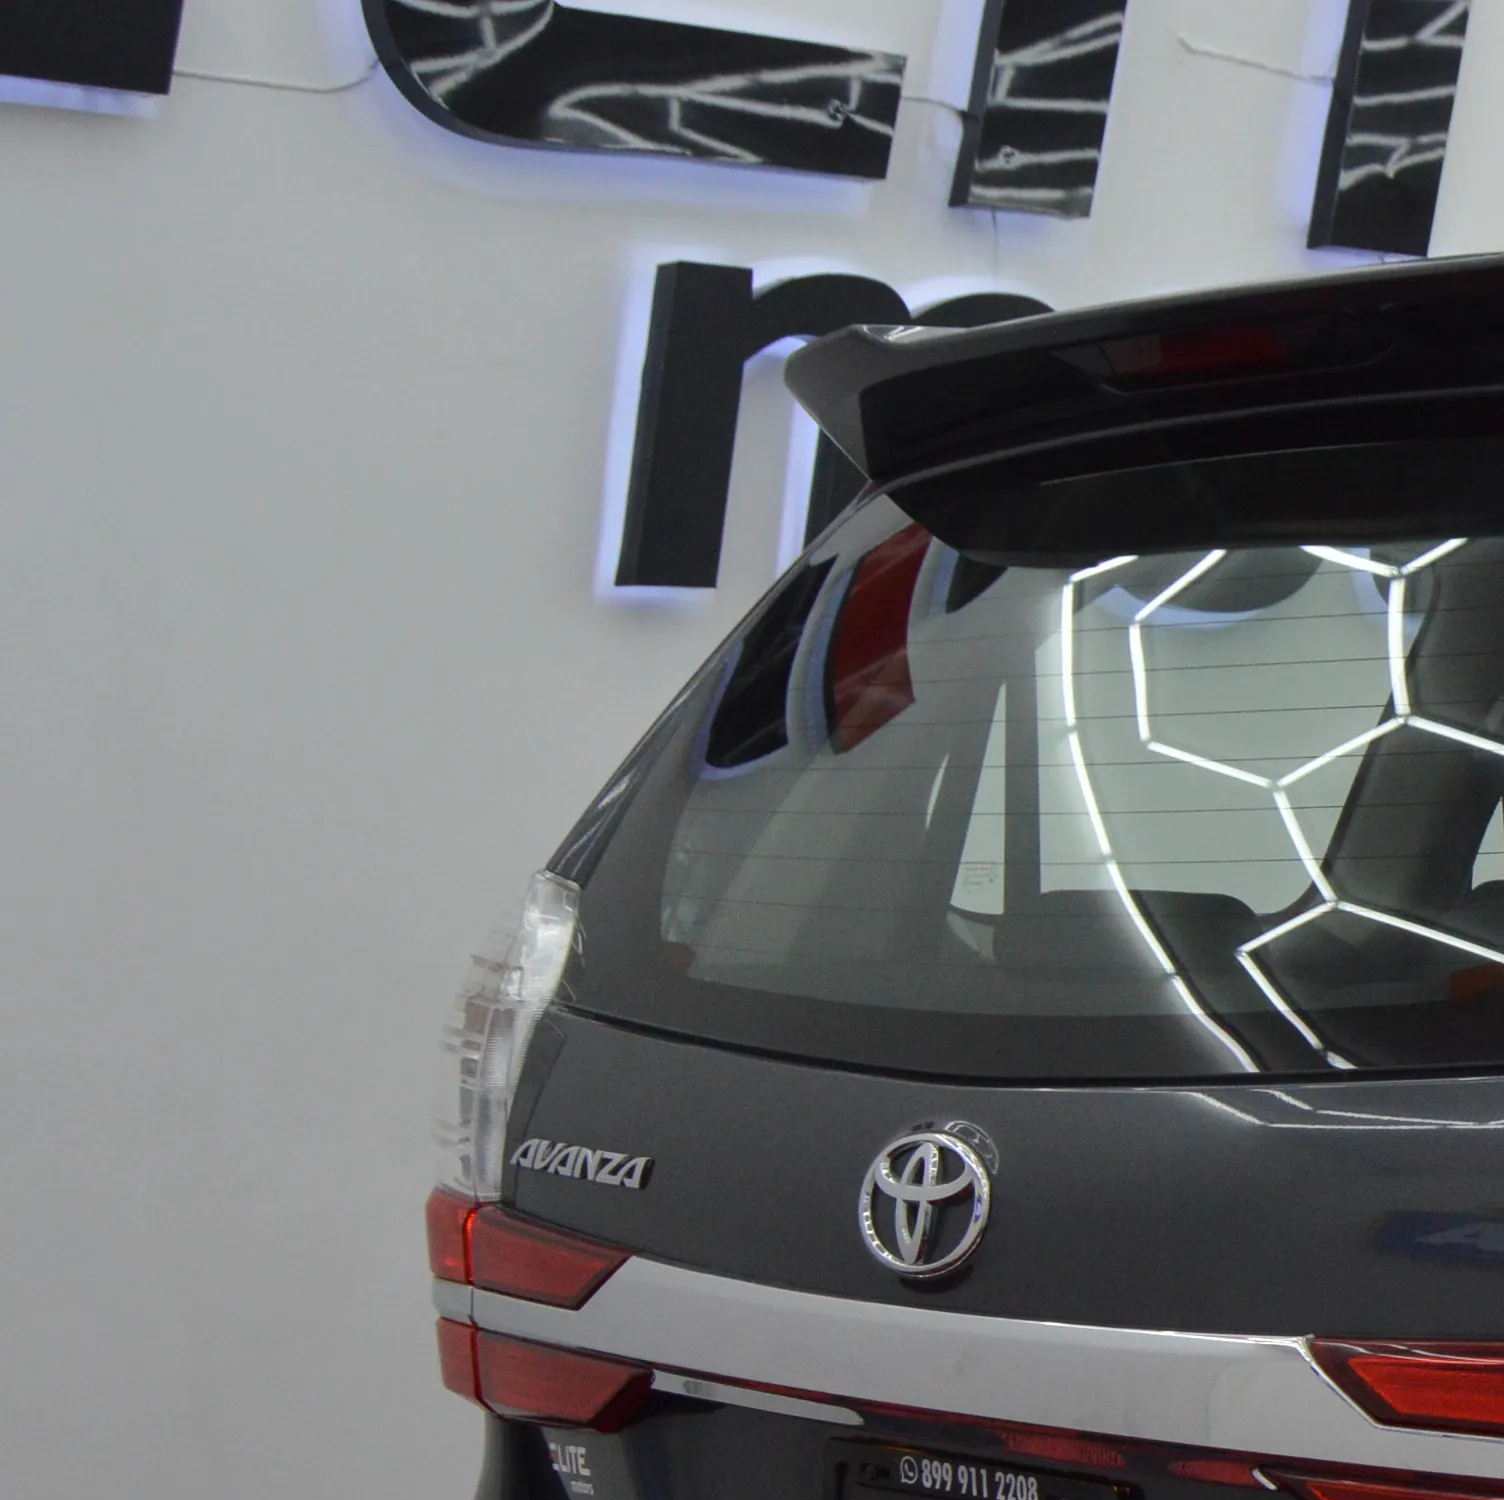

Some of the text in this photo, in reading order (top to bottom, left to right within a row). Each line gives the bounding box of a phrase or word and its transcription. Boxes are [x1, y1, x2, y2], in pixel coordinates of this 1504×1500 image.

[510, 1138, 652, 1189] AVANZA
[548, 1442, 591, 1476] ELITE
[920, 1458, 952, 1492] 899
[958, 1465, 988, 1498] 911
